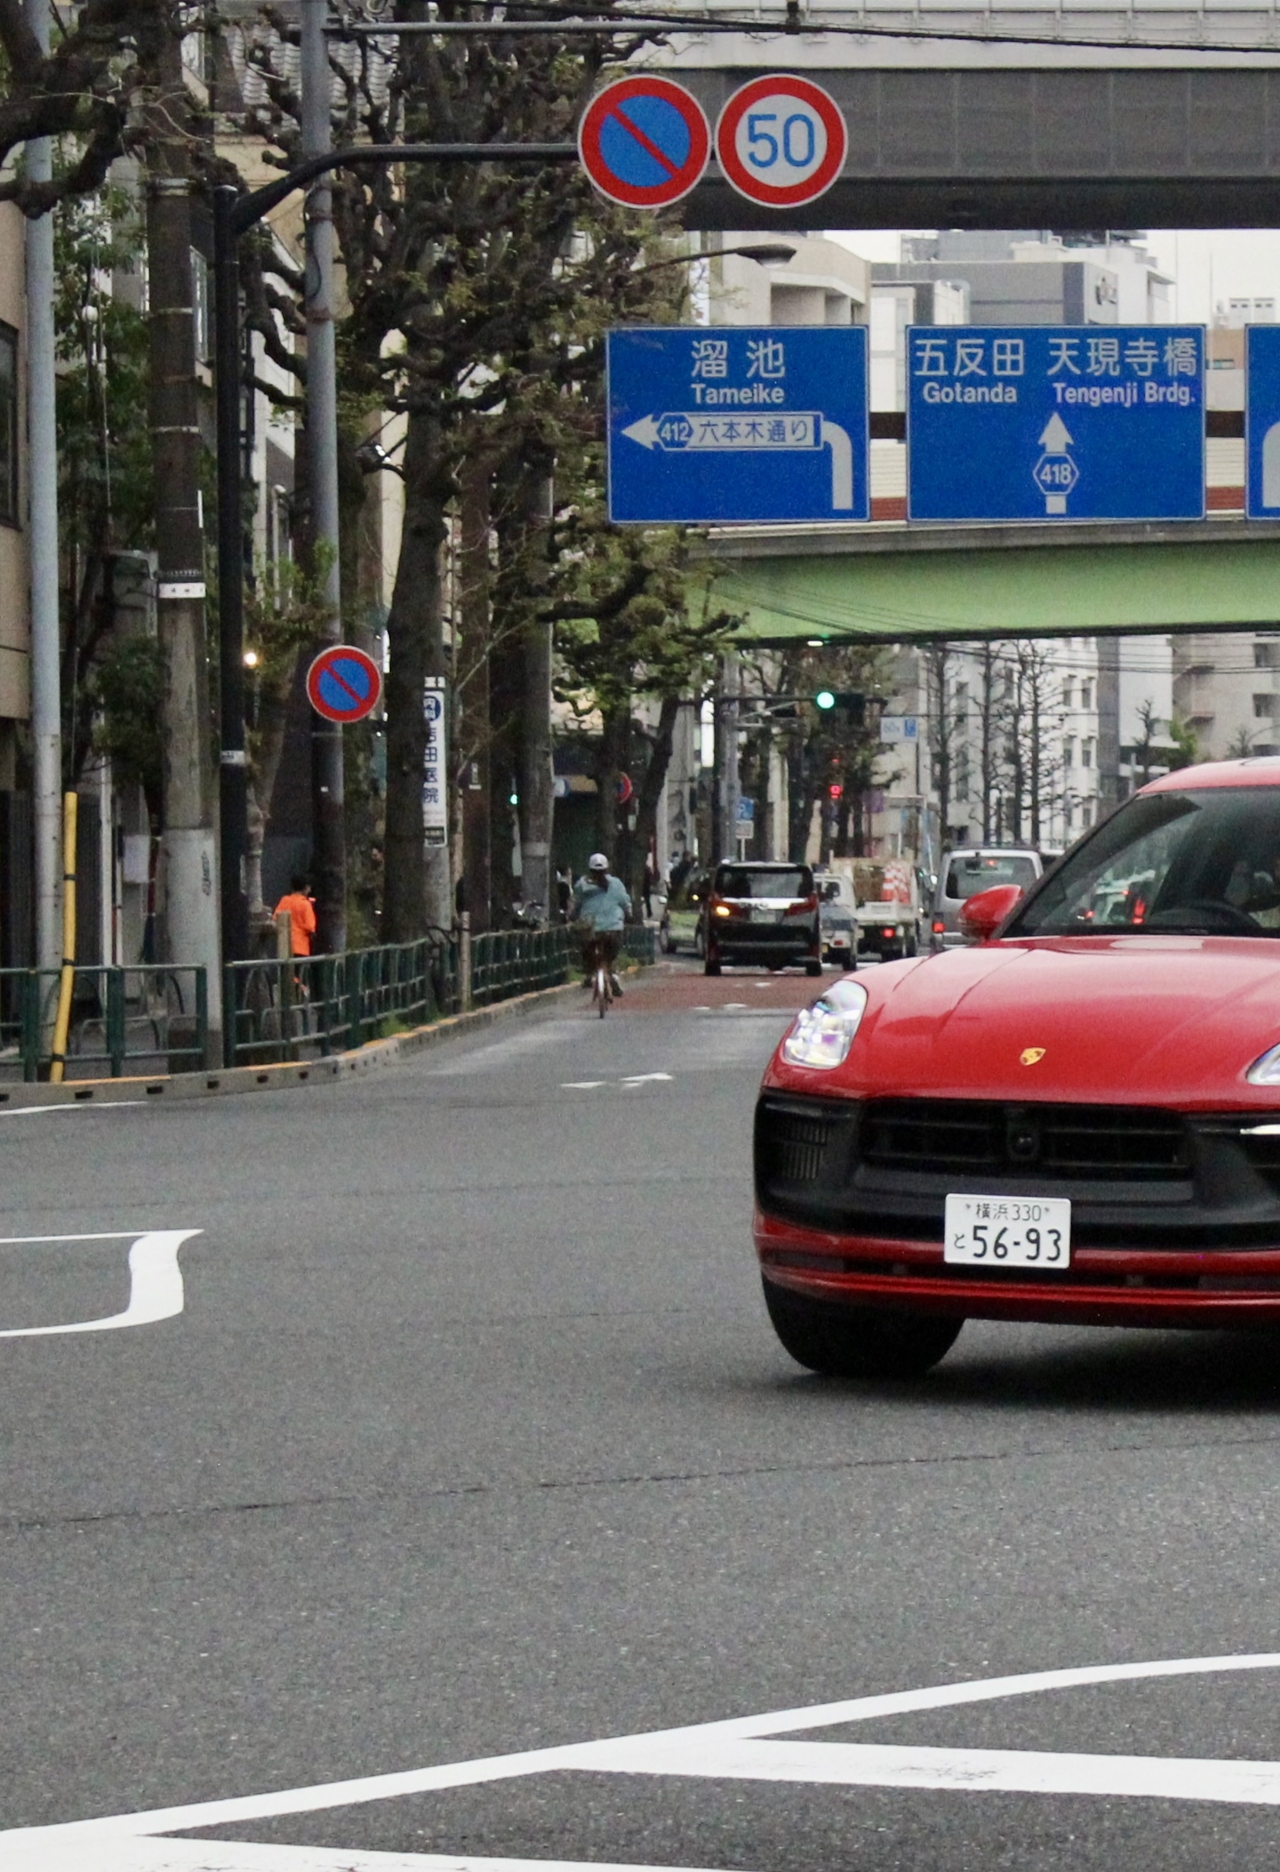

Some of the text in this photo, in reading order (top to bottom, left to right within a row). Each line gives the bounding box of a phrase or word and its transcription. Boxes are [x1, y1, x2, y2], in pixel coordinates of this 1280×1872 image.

[747, 113, 816, 168] 50
[691, 339, 786, 379] 溜池
[914, 337, 1198, 377] 五反田 天現寺橋
[691, 383, 785, 405] Tameike
[923, 382, 1196, 408] Gotanda Tengenji Brdg.
[659, 419, 810, 444] 412 六本木通り
[1041, 463, 1072, 485] 418
[953, 1225, 1062, 1262] と 56-93
